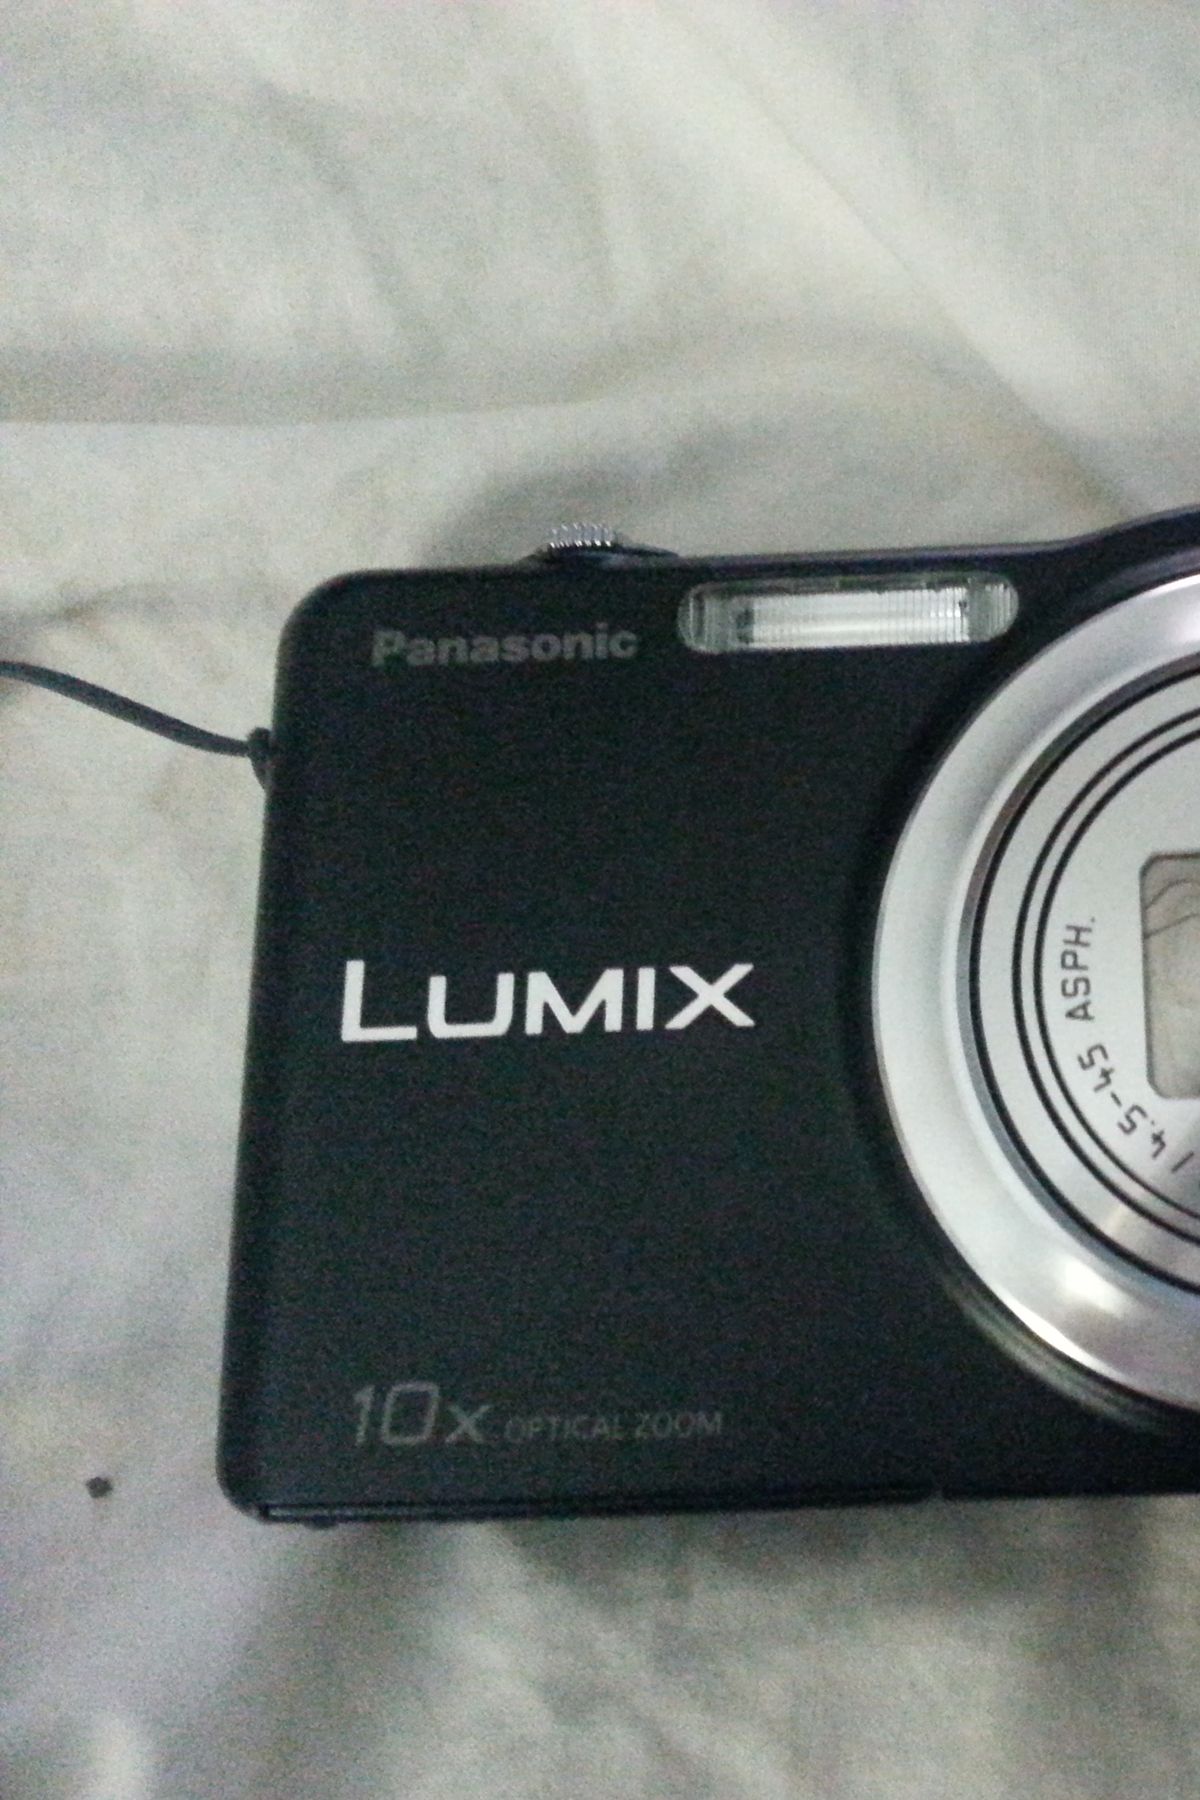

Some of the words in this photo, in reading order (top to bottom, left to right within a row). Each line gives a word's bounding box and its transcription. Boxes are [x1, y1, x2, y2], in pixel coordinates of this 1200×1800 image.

[371, 621, 638, 667] Panasonic
[340, 958, 756, 1043] LUMIX
[1060, 915, 1096, 1023] ASPH.
[504, 1413, 625, 1445] OPTICAL
[634, 1409, 723, 1439] ZOOM
